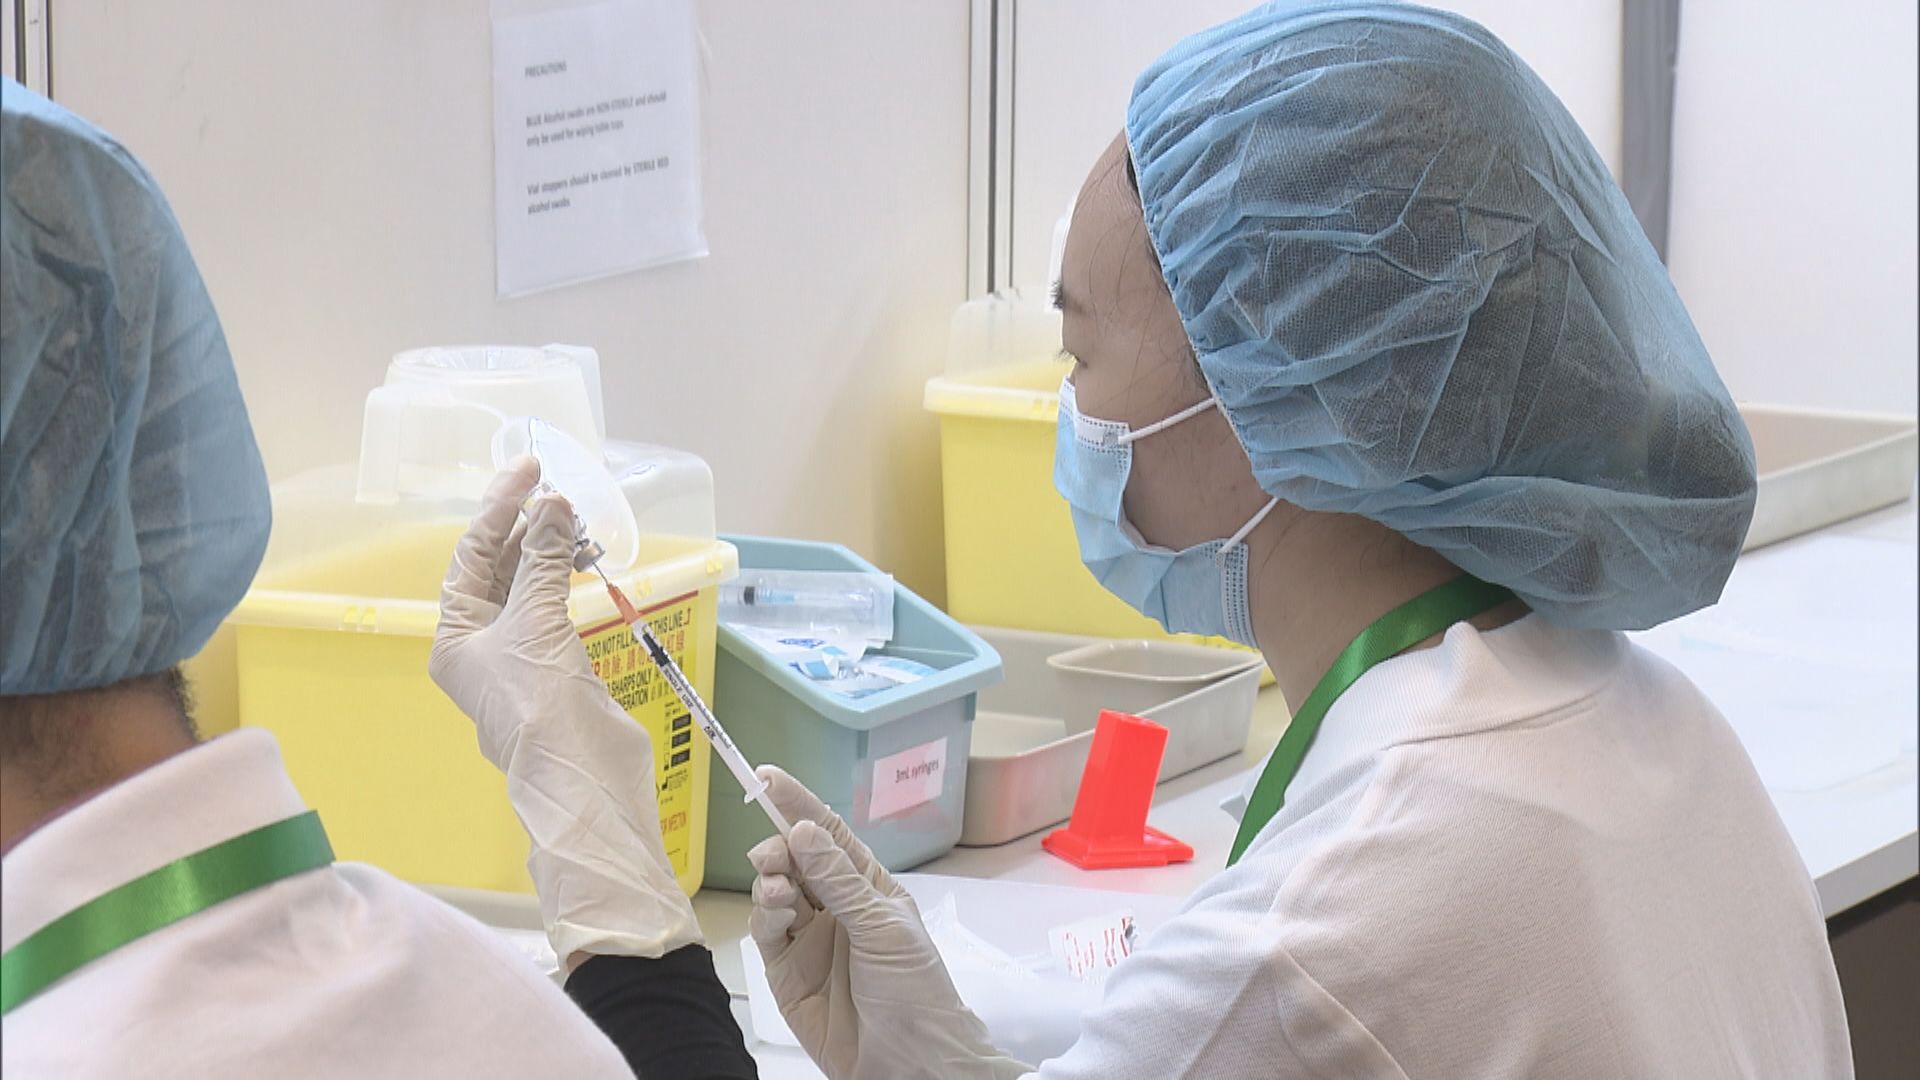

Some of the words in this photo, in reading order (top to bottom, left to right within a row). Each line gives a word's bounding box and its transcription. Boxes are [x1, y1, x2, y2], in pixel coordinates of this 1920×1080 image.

[525, 61, 567, 78] PRECAUTIONS
[635, 95, 646, 107] and
[647, 90, 667, 104] should
[526, 135, 540, 148] only
[541, 132, 549, 144] be
[550, 130, 565, 143] used
[566, 128, 574, 139] for
[575, 125, 594, 139] wiping
[527, 183, 539, 196] Vial
[569, 172, 589, 188] should
[591, 171, 599, 183] be
[600, 166, 622, 180] cleaned
[623, 165, 631, 177] by
[633, 159, 655, 174] STERILE
[657, 156, 669, 169] RED
[528, 202, 550, 215] alcohol
[551, 197, 571, 210] swabs
[602, 636, 616, 655] NOT
[616, 631, 630, 650] FILL
[654, 616, 668, 636] THIS
[668, 610, 684, 631] LINE
[611, 673, 636, 697] SHARPS
[636, 667, 652, 688] ONLY
[911, 760, 939, 779] syringes
